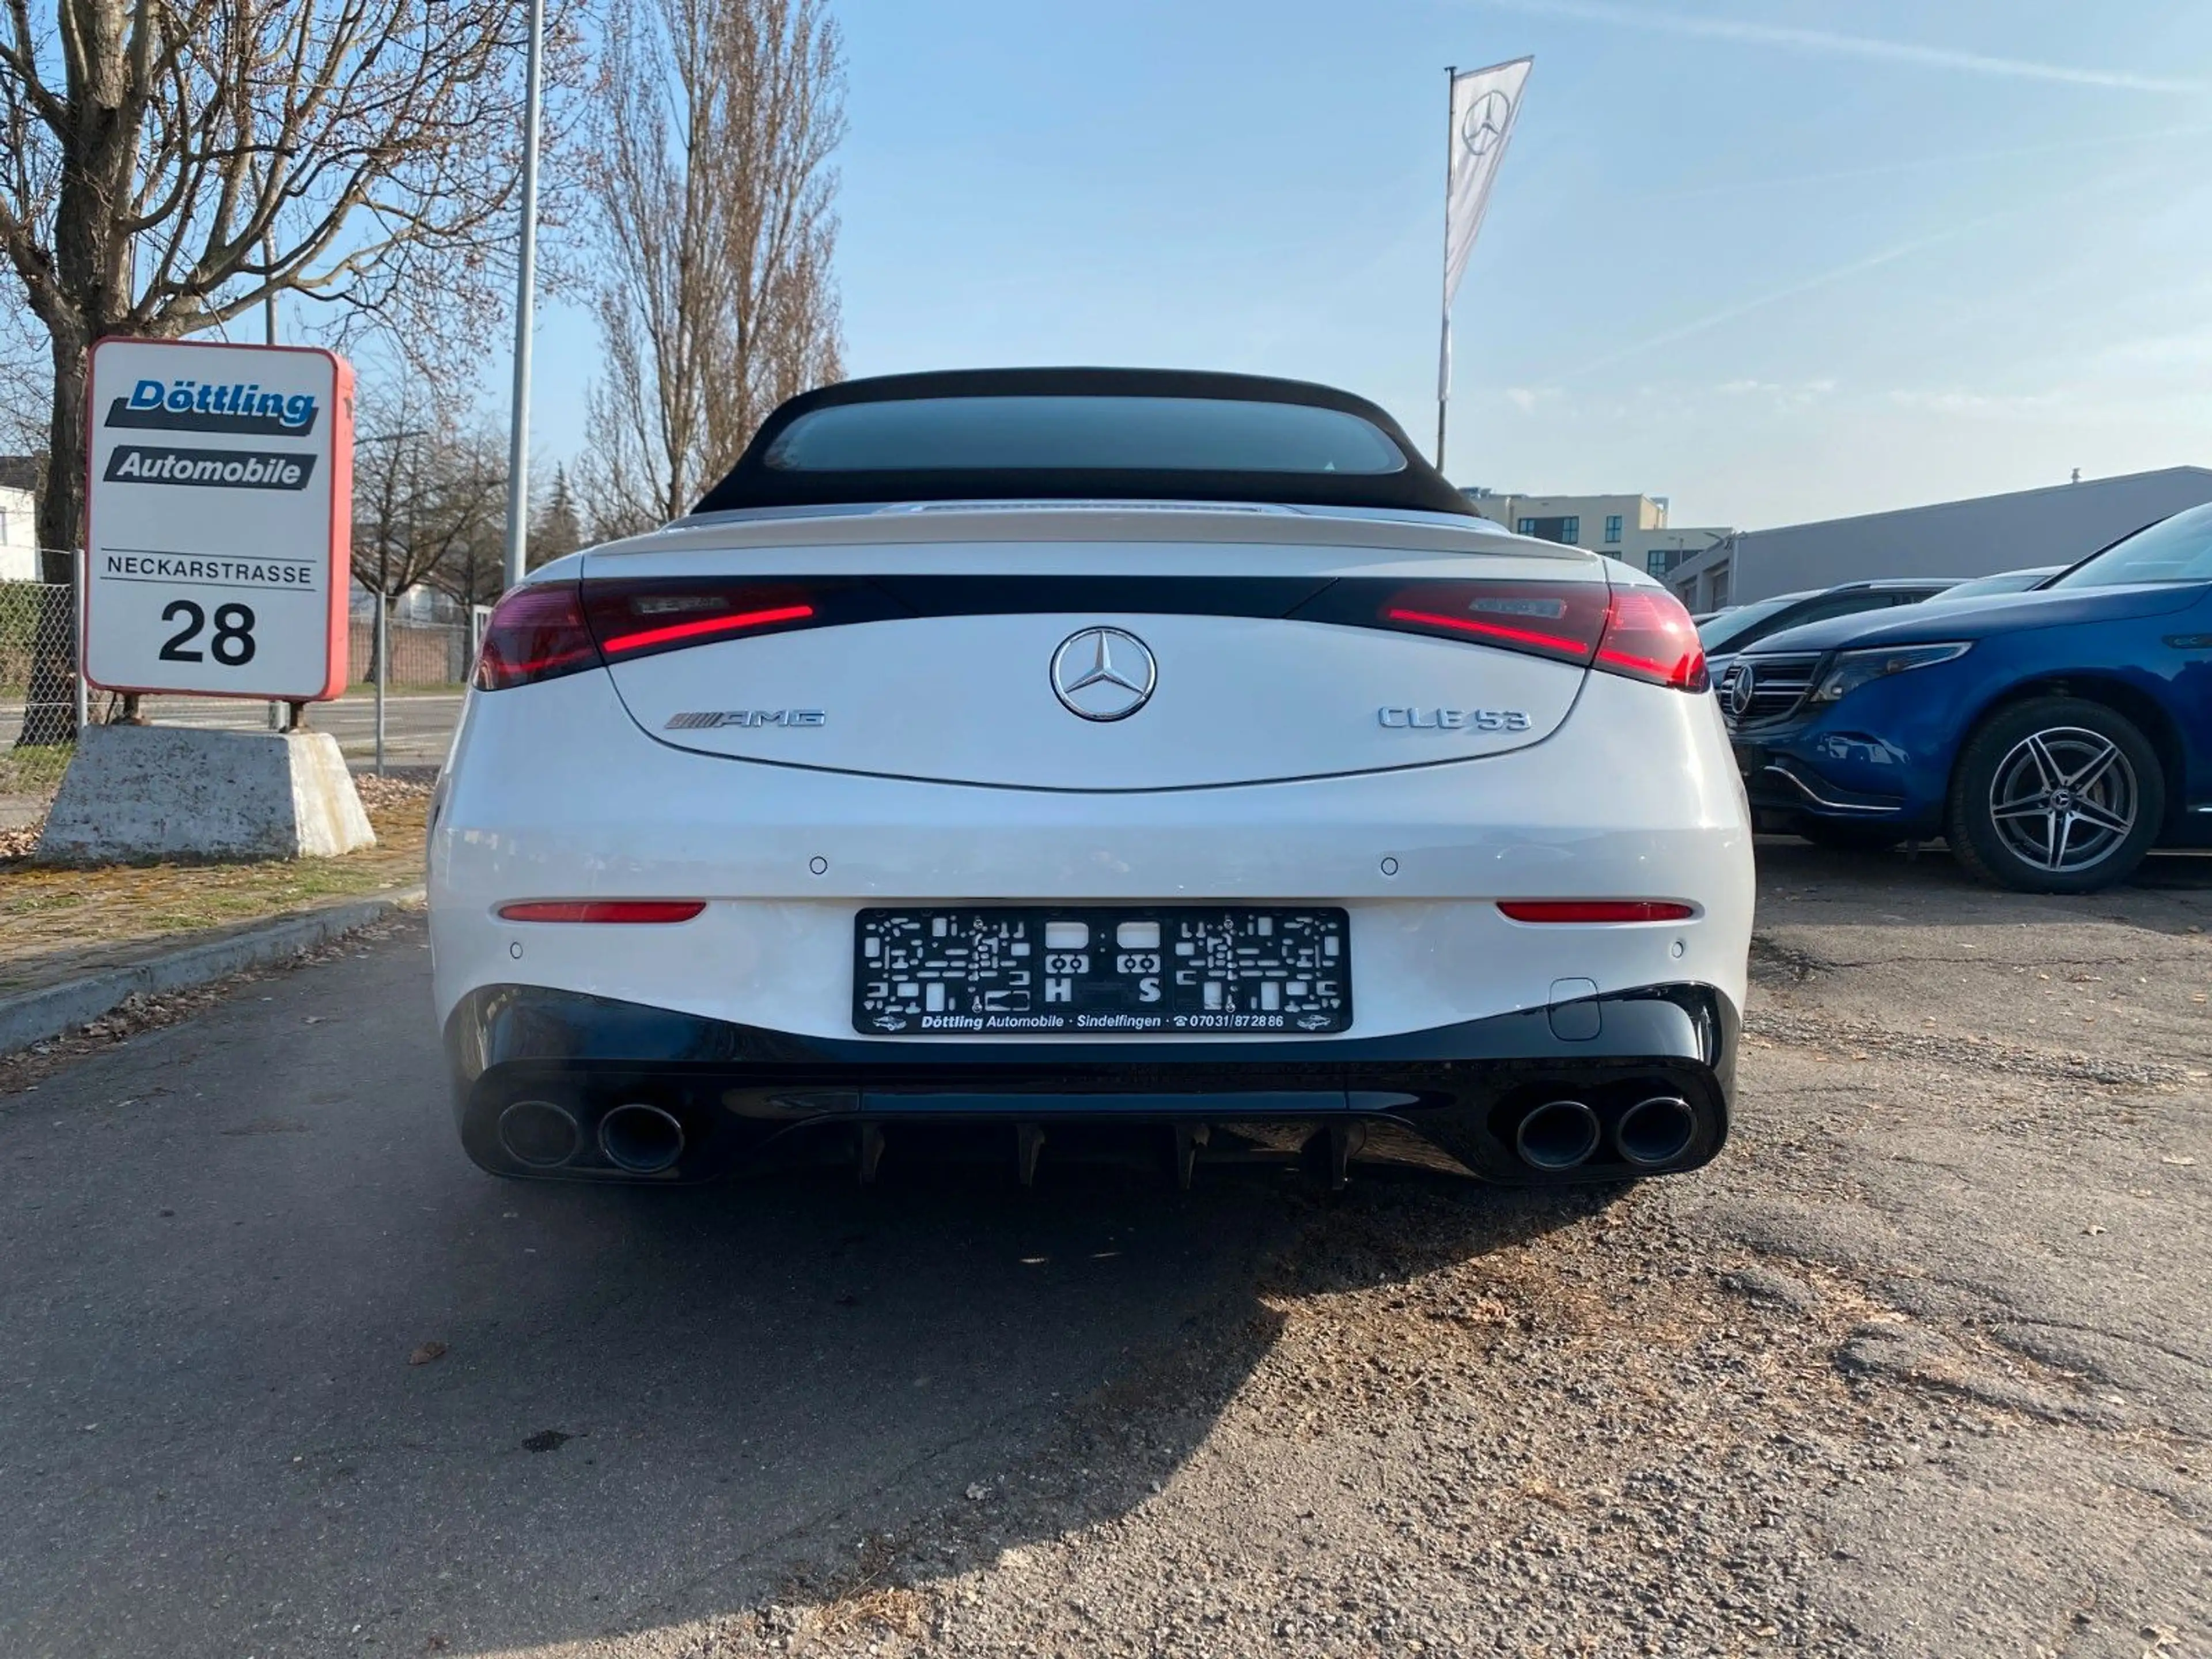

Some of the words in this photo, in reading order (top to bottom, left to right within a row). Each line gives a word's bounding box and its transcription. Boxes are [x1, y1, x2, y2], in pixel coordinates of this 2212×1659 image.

[126, 380, 315, 427] Döttling
[116, 451, 302, 484] Automobile
[107, 555, 312, 584] NECKARSTRASSE
[158, 600, 256, 666] 28
[718, 710, 825, 727] AMG
[1378, 707, 1466, 729] CLE
[1476, 709, 1532, 730] 53
[922, 1016, 983, 1031] Döttling
[986, 1015, 1064, 1027] Automobile
[1077, 1015, 1161, 1029] Sindelfingen
